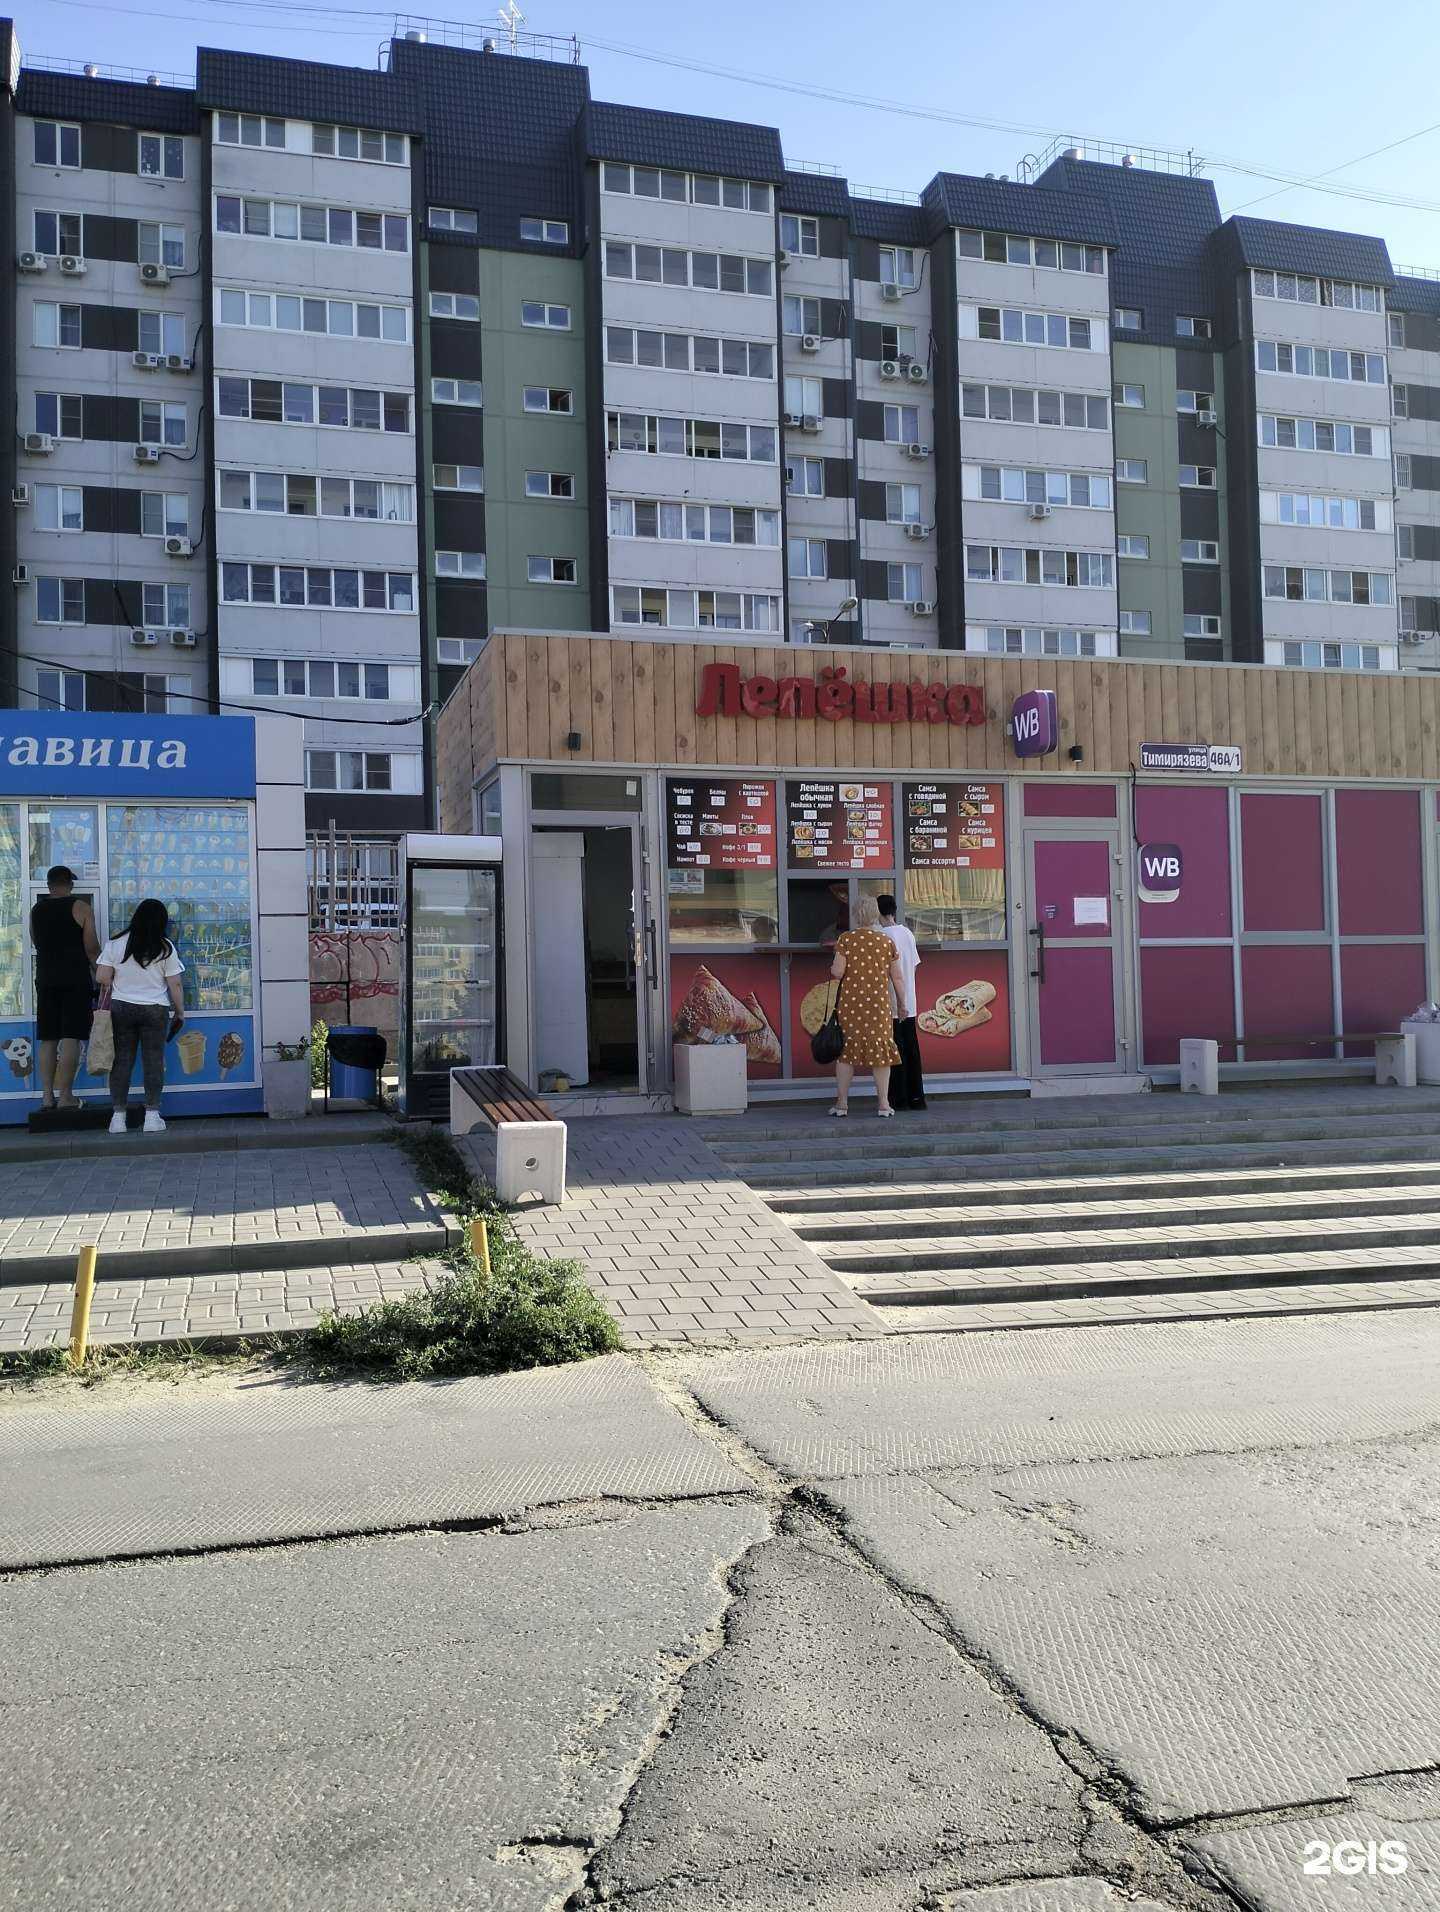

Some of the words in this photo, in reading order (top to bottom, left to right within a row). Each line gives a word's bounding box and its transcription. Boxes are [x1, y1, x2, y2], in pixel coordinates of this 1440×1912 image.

[695, 663, 986, 726] Лепёшка
[1014, 708, 1040, 741] WB
[0, 736, 187, 770] авица
[1142, 752, 1207, 767] Тимирязева
[1210, 752, 1240, 766] 46А/1
[799, 783, 835, 792] Лепёшка
[918, 784, 937, 792] Самса
[967, 785, 986, 793] Самса
[799, 792, 834, 802] обычная
[914, 793, 947, 801] говядиной
[911, 857, 930, 865] Самса
[931, 858, 955, 866] ассорти
[1144, 857, 1180, 877] WB
